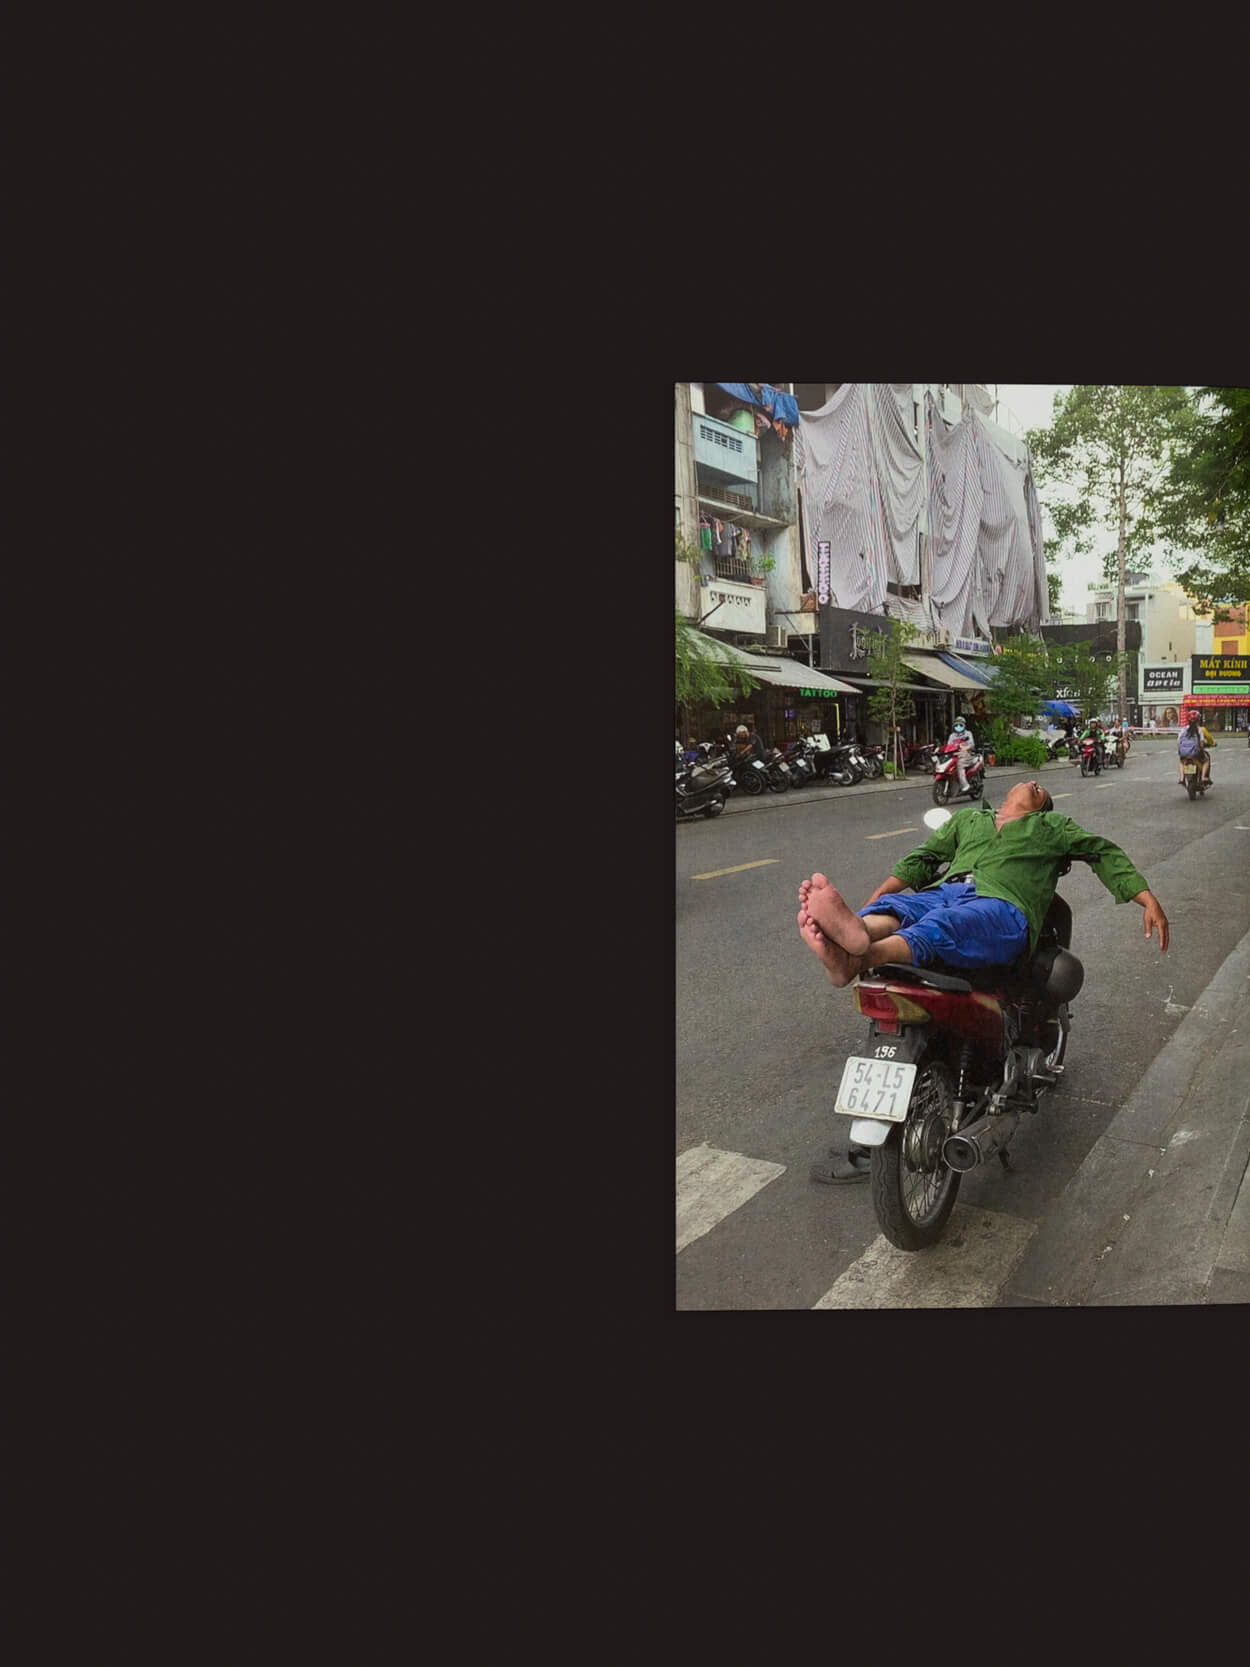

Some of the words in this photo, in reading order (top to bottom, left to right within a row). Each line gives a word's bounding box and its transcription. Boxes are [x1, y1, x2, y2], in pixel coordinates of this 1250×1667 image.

[1149, 671, 1178, 679] OCEAN
[800, 688, 837, 698] TATTOO
[854, 1062, 905, 1089] 54-L5
[847, 1087, 897, 1116] 6471
